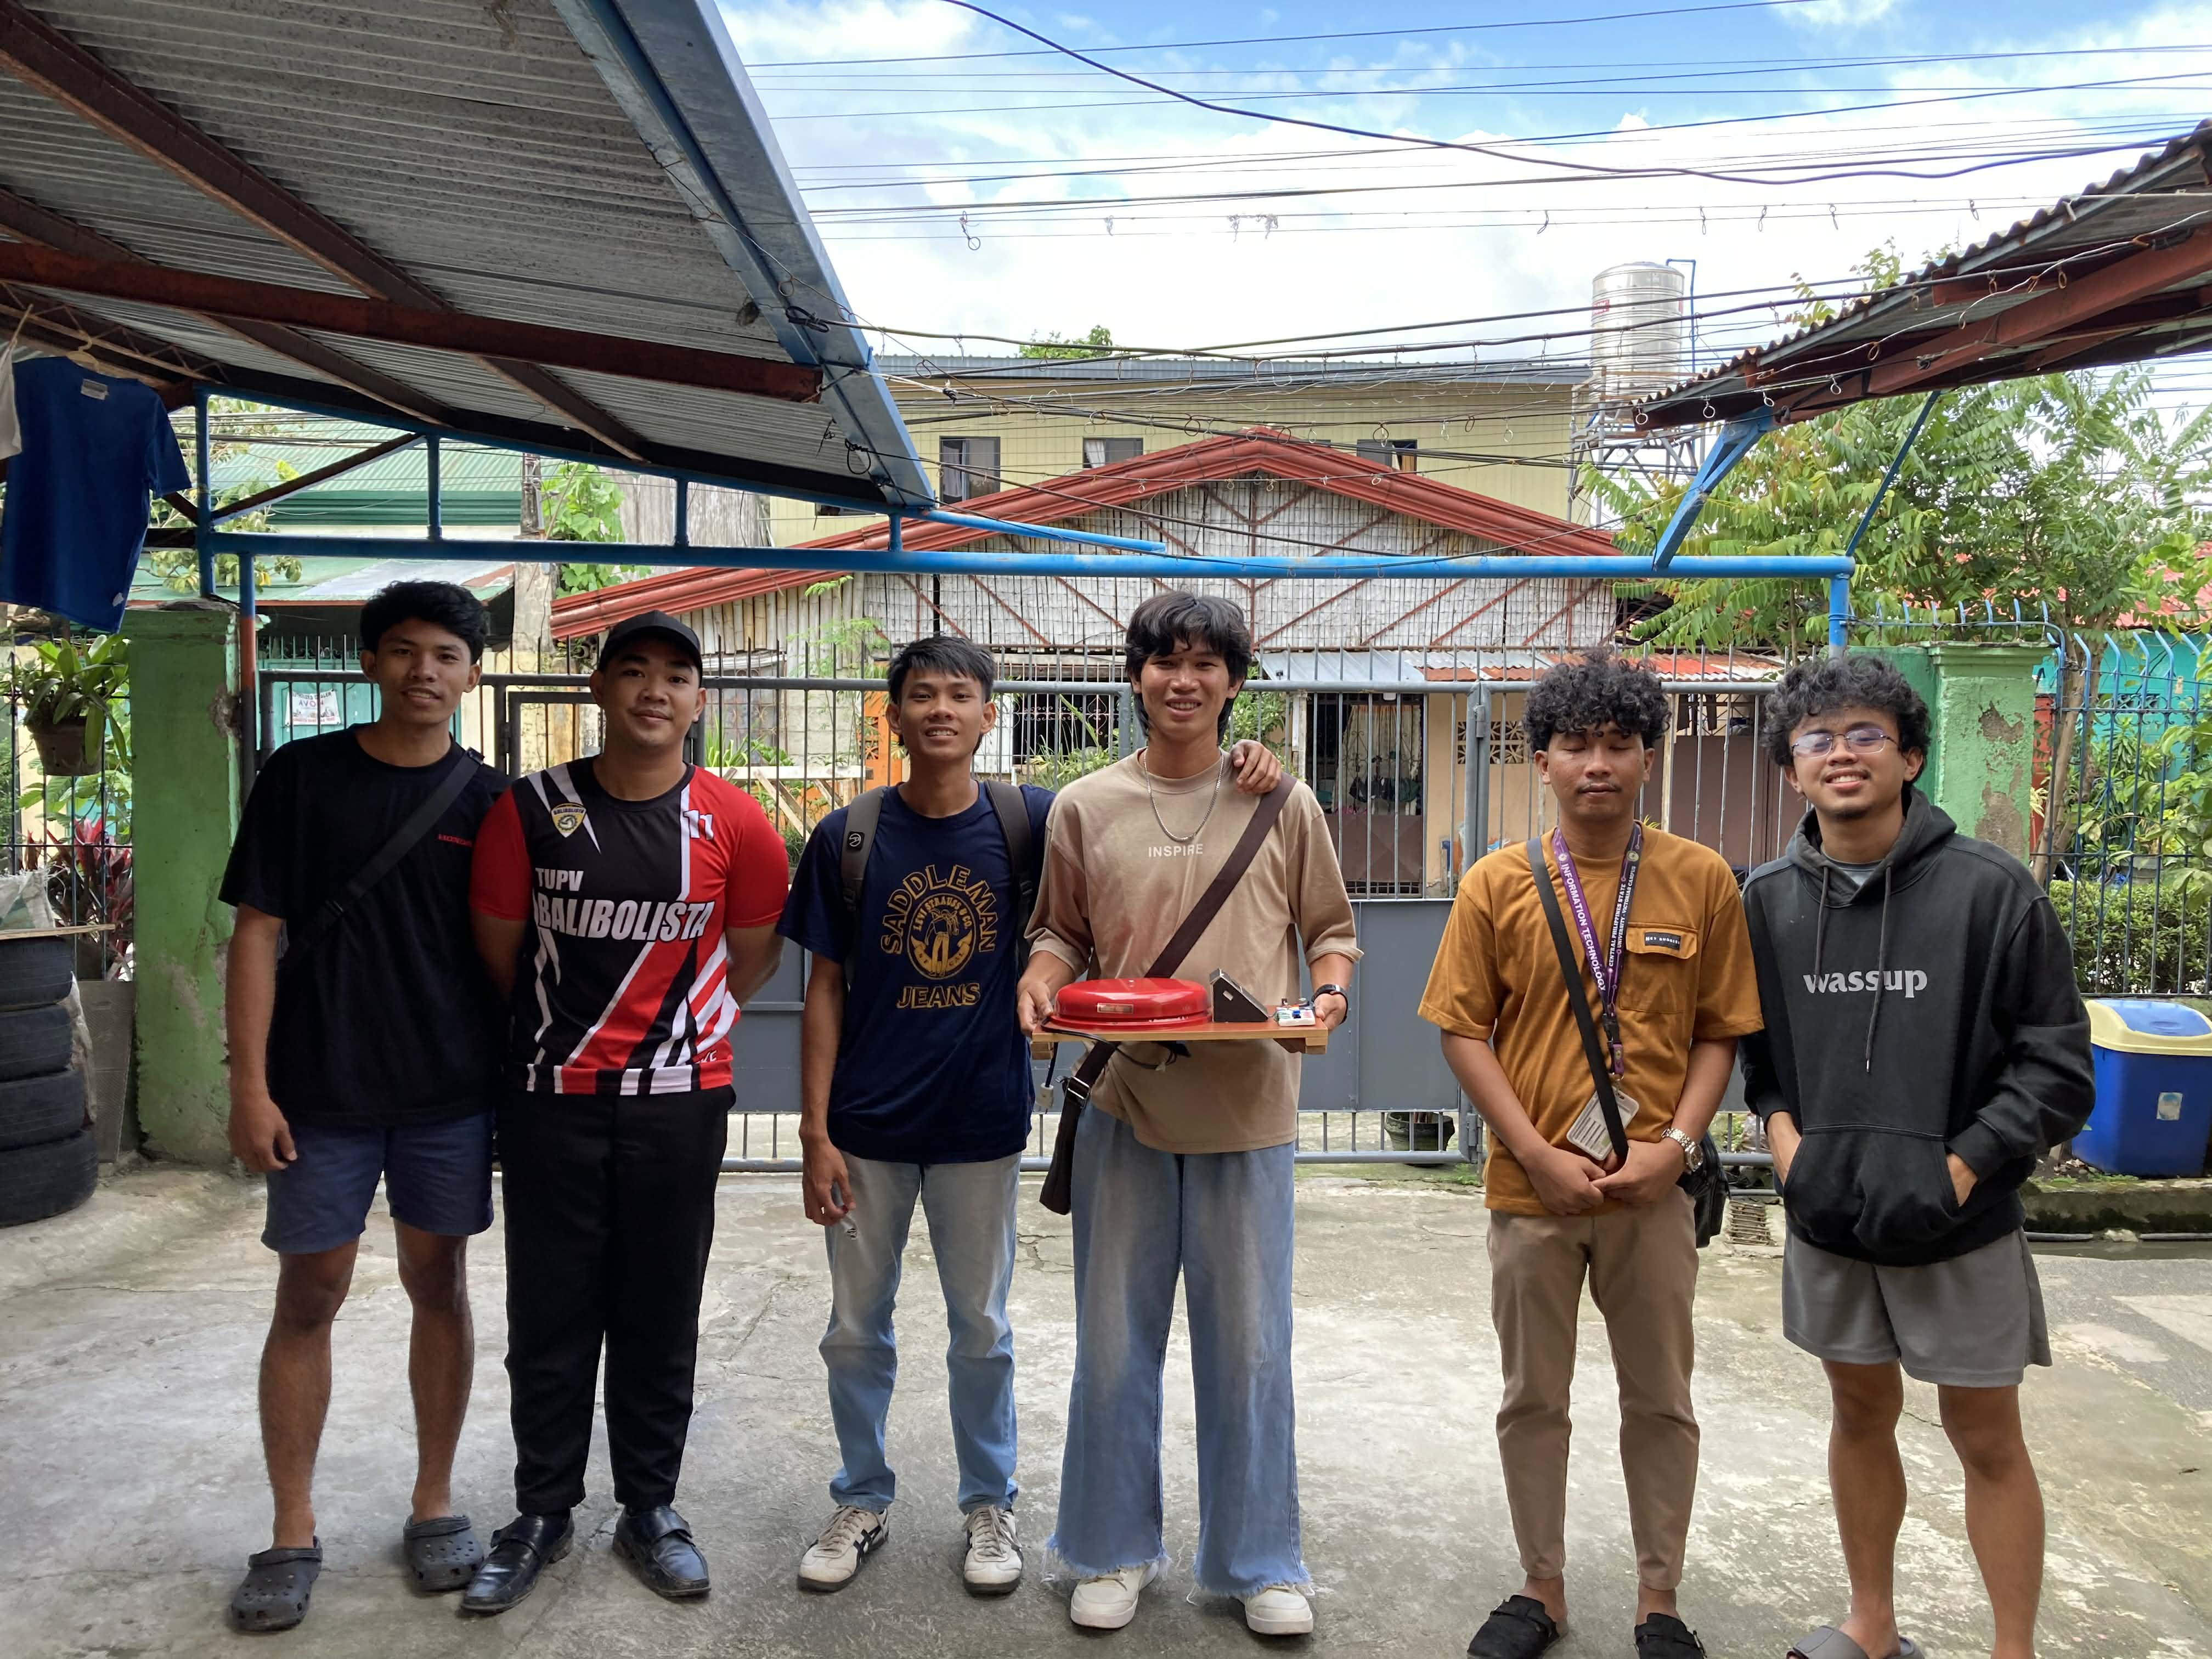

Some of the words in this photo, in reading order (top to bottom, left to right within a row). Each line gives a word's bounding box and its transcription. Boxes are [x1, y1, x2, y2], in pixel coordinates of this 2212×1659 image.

[314, 692, 332, 700] DALER
[1148, 843, 1203, 857] INSPIRE
[535, 867, 584, 891] TUPV
[537, 891, 715, 941] BALIBOLISTA
[881, 864, 998, 955] SADDLEMAN
[1611, 904, 1622, 939] PHILIPPINES
[1618, 883, 1626, 902] STATE
[1617, 917, 1626, 948] UNIVERSITY
[1622, 887, 1632, 913] VICTORIAS
[1628, 866, 1636, 886] CAMPUS
[1561, 863, 1588, 926] INFORMATION
[1582, 927, 1606, 991] TECHNOLOGY
[896, 983, 981, 1009] JEANS
[1802, 969, 1928, 998] wassup
